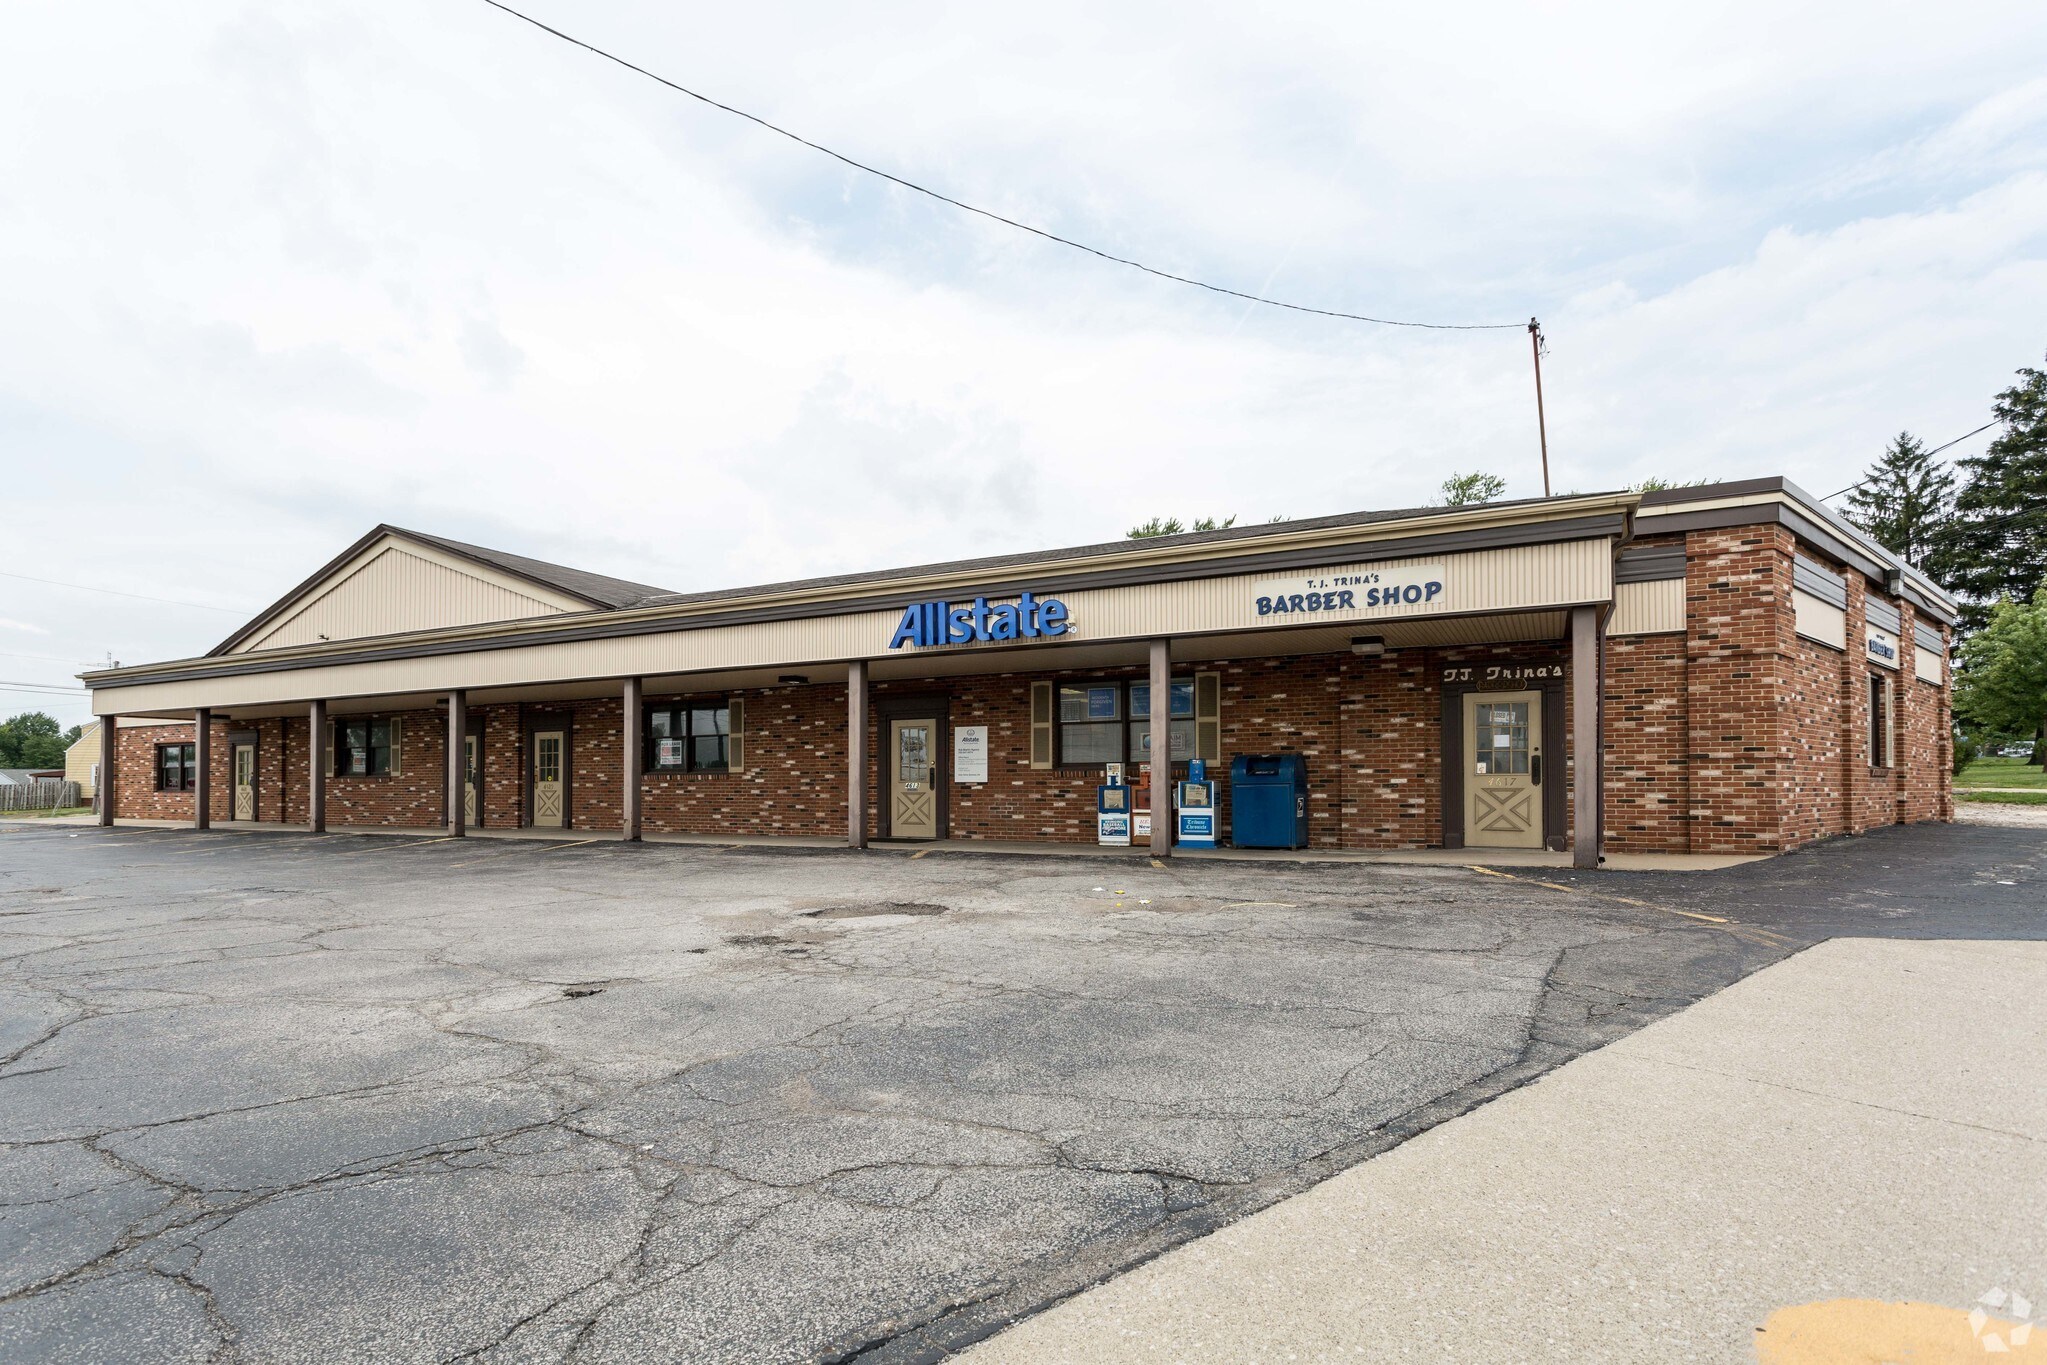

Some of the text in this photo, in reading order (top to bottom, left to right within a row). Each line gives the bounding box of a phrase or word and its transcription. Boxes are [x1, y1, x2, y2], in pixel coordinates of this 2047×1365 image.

[1307, 572, 1380, 589] T. J. TRINA'S
[1255, 580, 1443, 616] BARBER SHOP
[888, 591, 1069, 649] Allstate
[1486, 665, 1563, 680] Trina's
[1488, 777, 1517, 787] 4617
